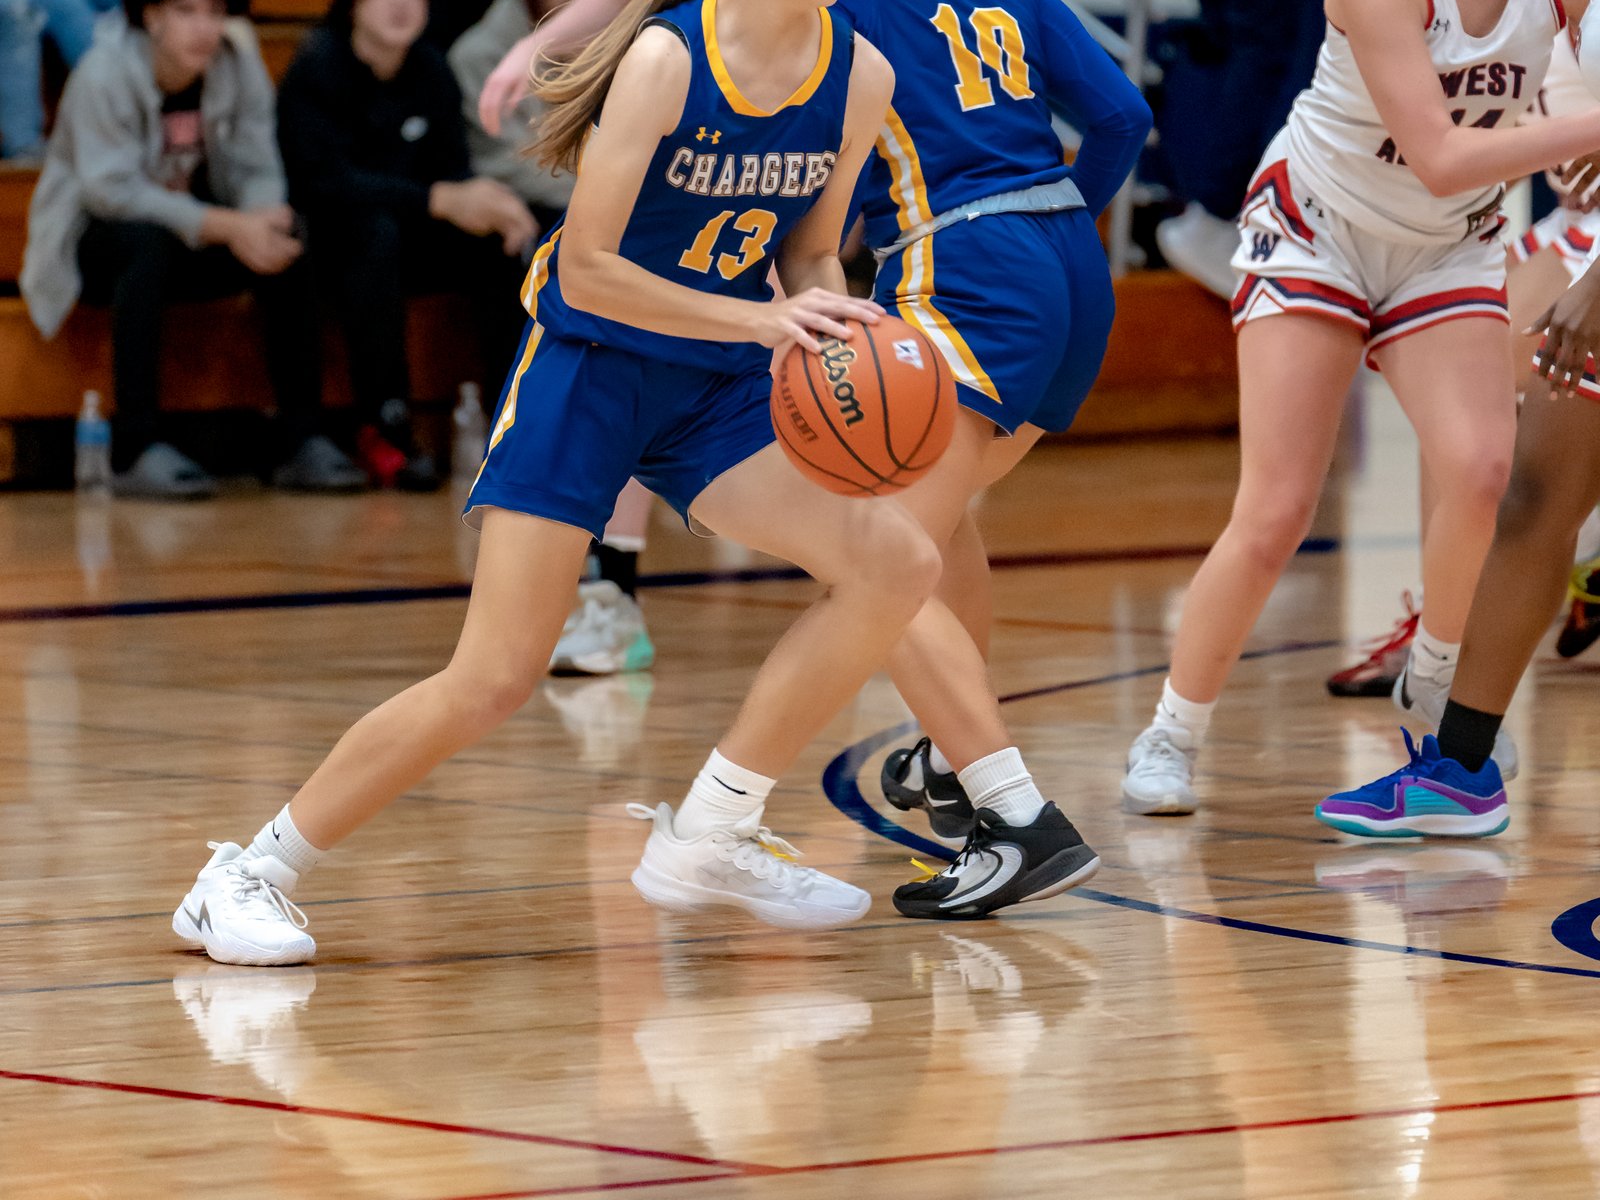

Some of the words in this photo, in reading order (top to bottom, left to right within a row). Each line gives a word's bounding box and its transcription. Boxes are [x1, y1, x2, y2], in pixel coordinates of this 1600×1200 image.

[929, 3, 1035, 112] 10
[1439, 62, 1526, 99] WEST
[665, 146, 838, 197] CHARGERS
[678, 208, 778, 280] 13
[816, 331, 865, 428] ilson
